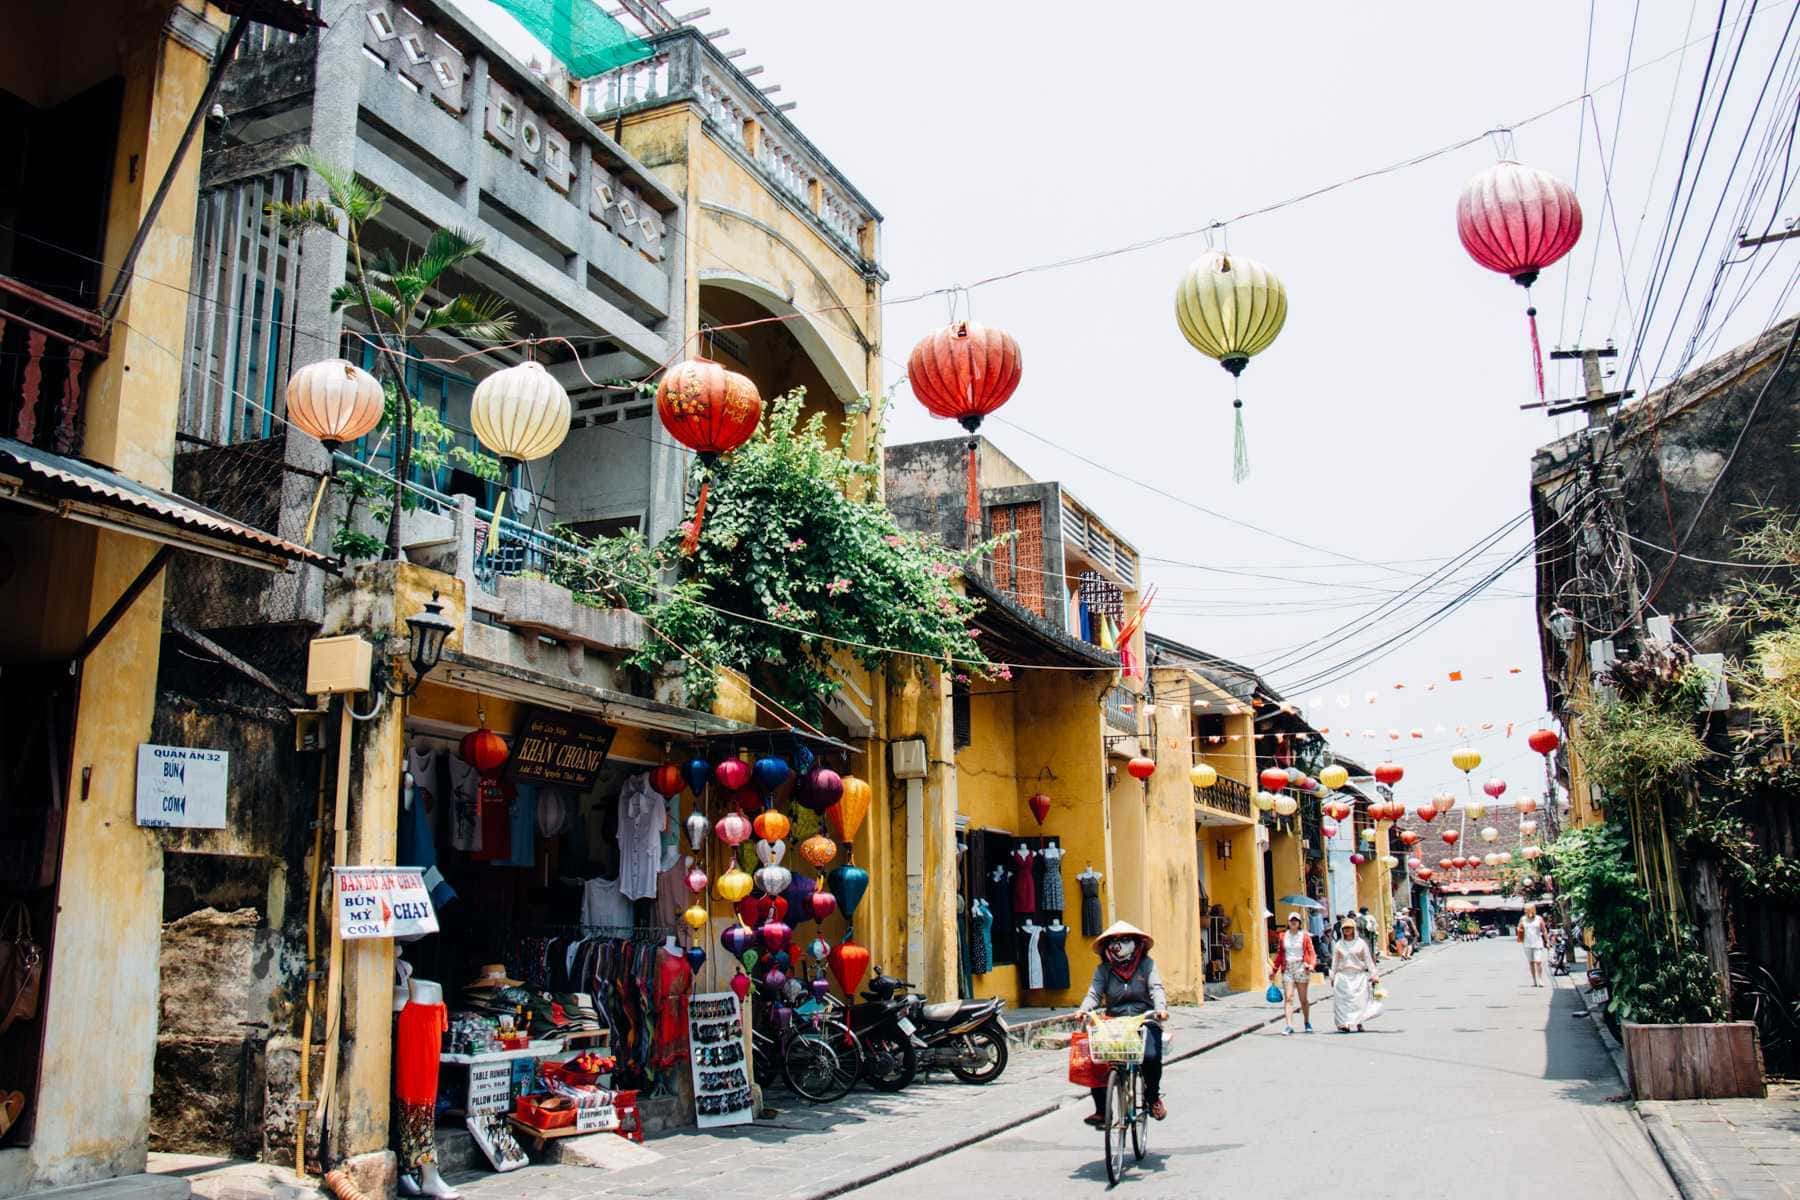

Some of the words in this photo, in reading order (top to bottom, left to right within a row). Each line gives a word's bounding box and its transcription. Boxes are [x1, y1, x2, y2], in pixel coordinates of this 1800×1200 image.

[207, 753, 221, 762] 32
[397, 873, 422, 889] CHAY
[344, 894, 376, 907] BÚN
[393, 902, 428, 920] CHAY
[473, 1070, 488, 1081] TABLE
[489, 1068, 511, 1079] RUNNER
[472, 1095, 491, 1106] PILLOW
[492, 1092, 510, 1103] CASES
